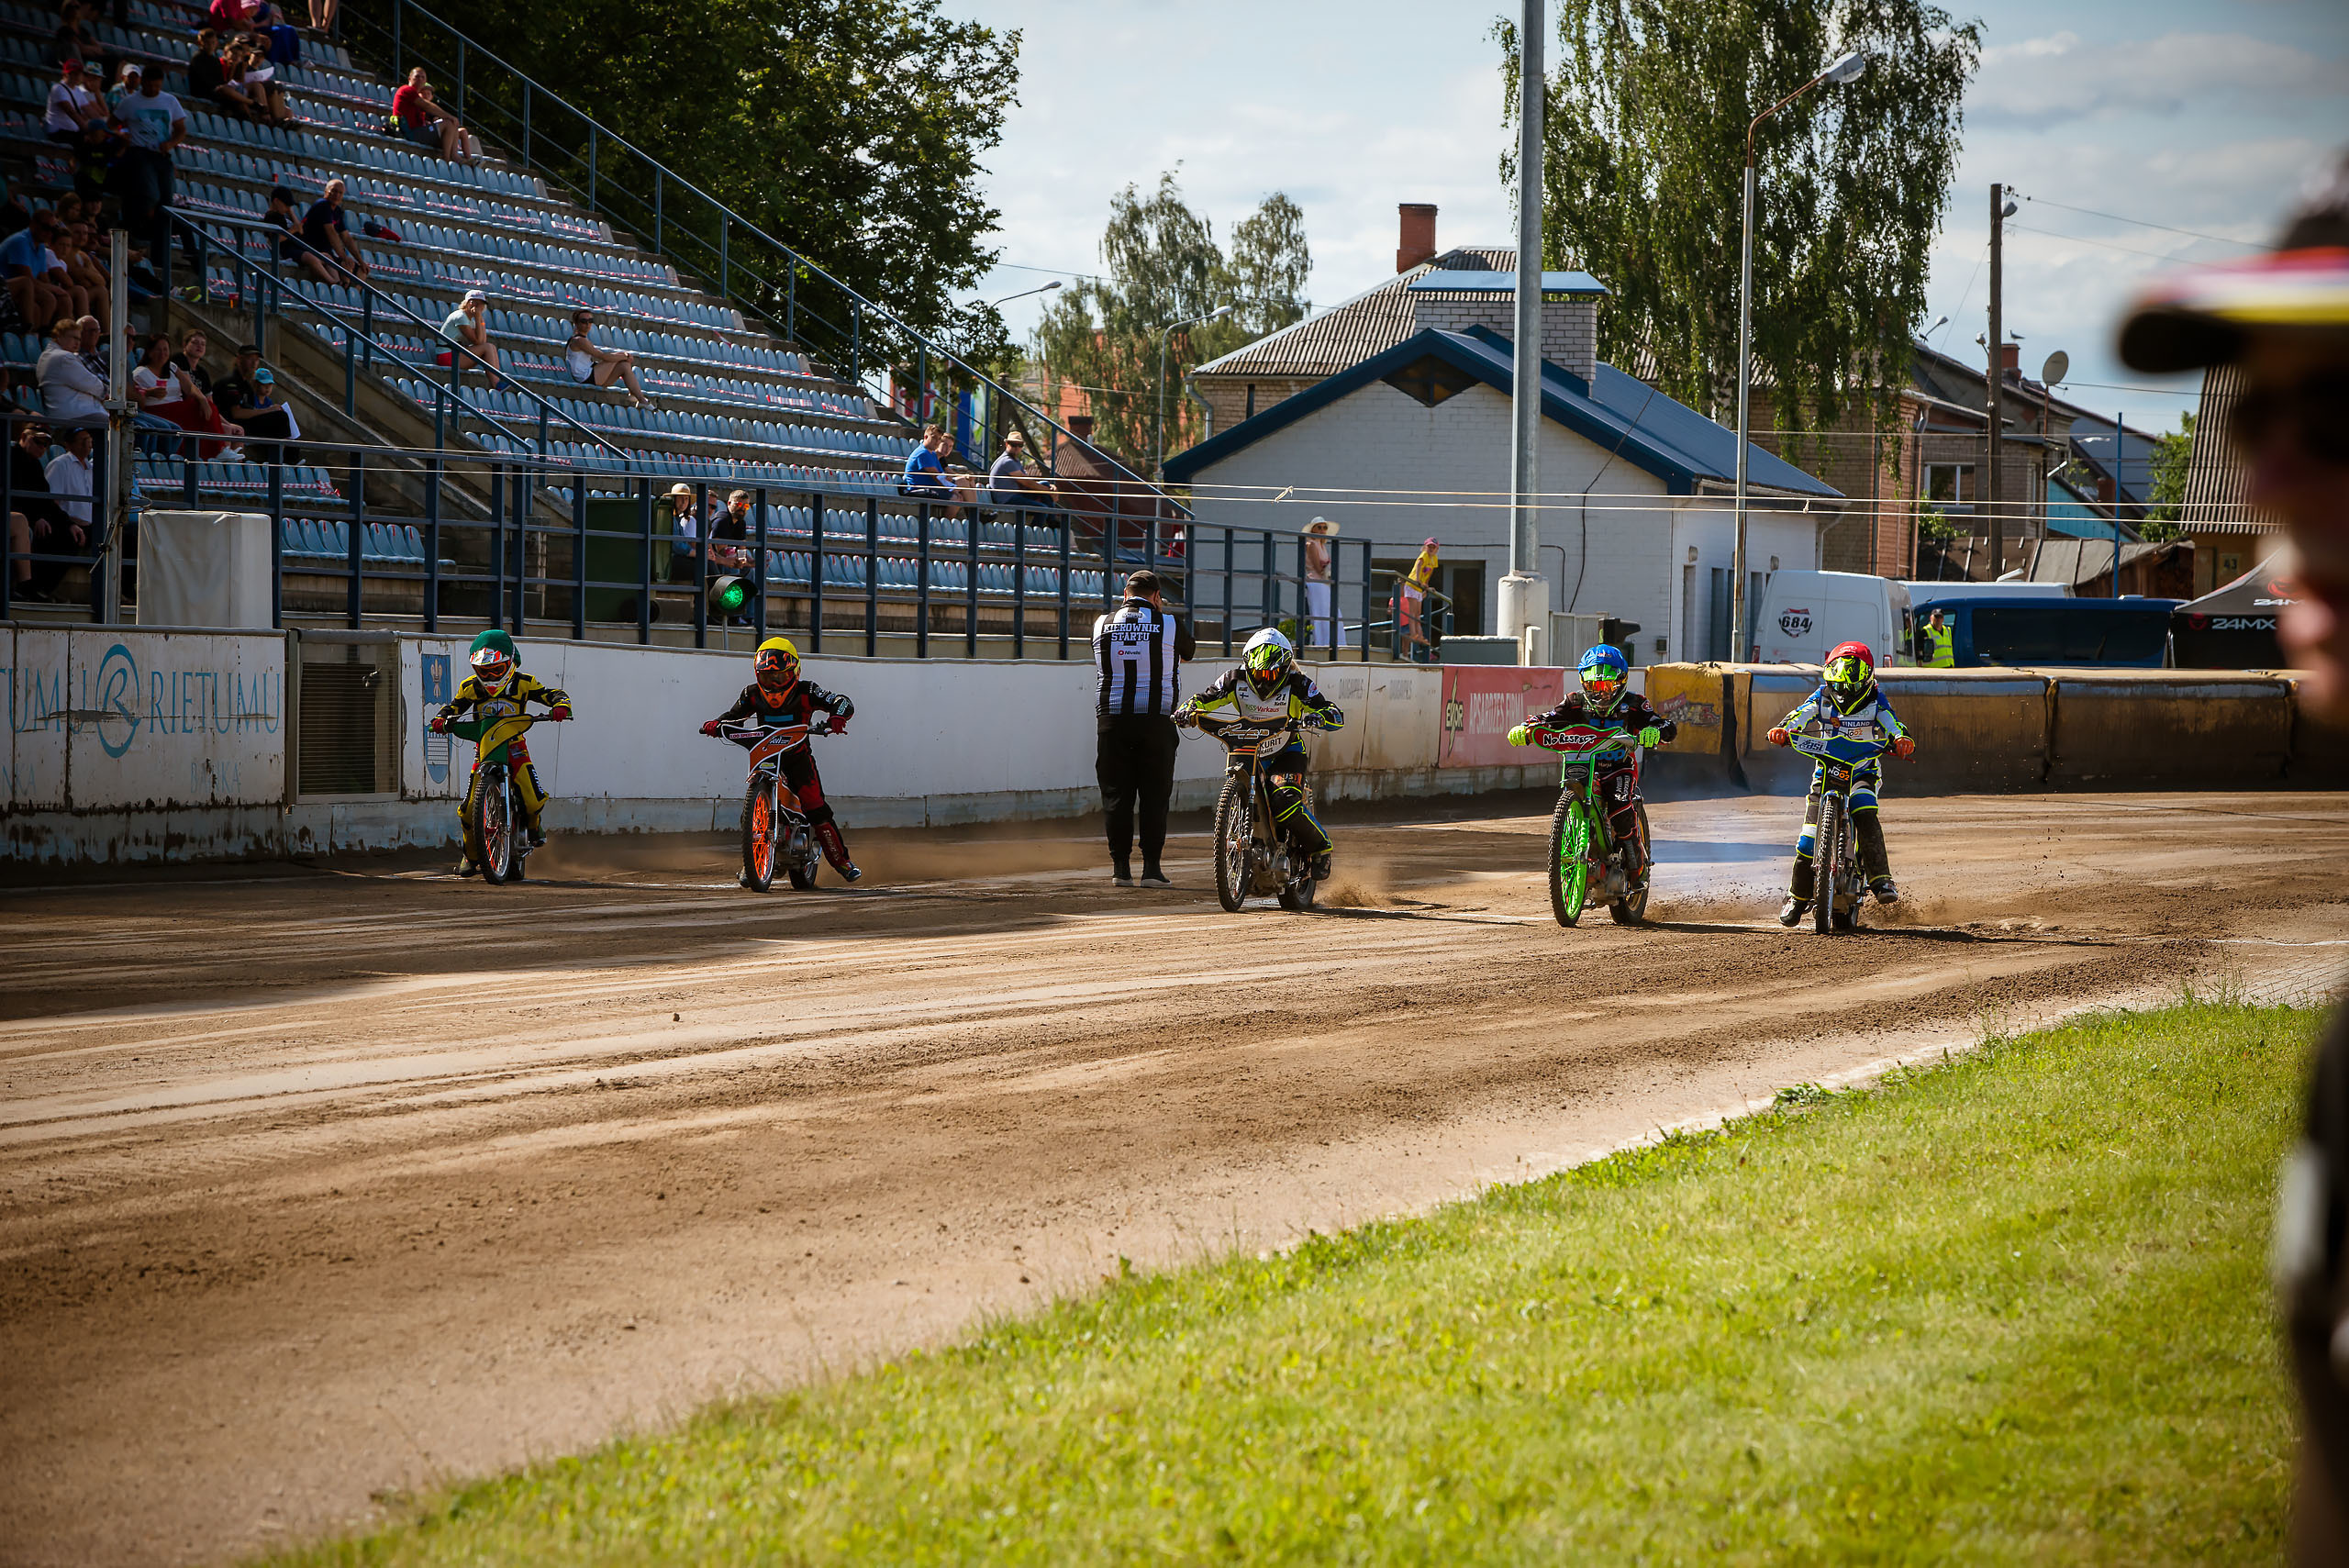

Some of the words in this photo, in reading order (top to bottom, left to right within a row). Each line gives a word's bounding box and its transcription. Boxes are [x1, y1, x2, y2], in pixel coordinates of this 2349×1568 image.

[2223, 558, 2238, 570] 43
[1103, 623, 1161, 633] KIEROWNIK
[1782, 615, 1810, 629] 684
[2211, 617, 2277, 630] 24MX
[1111, 632, 1150, 641] STARTU
[149, 670, 281, 735] RIETUMU
[1275, 693, 1287, 701] 21
